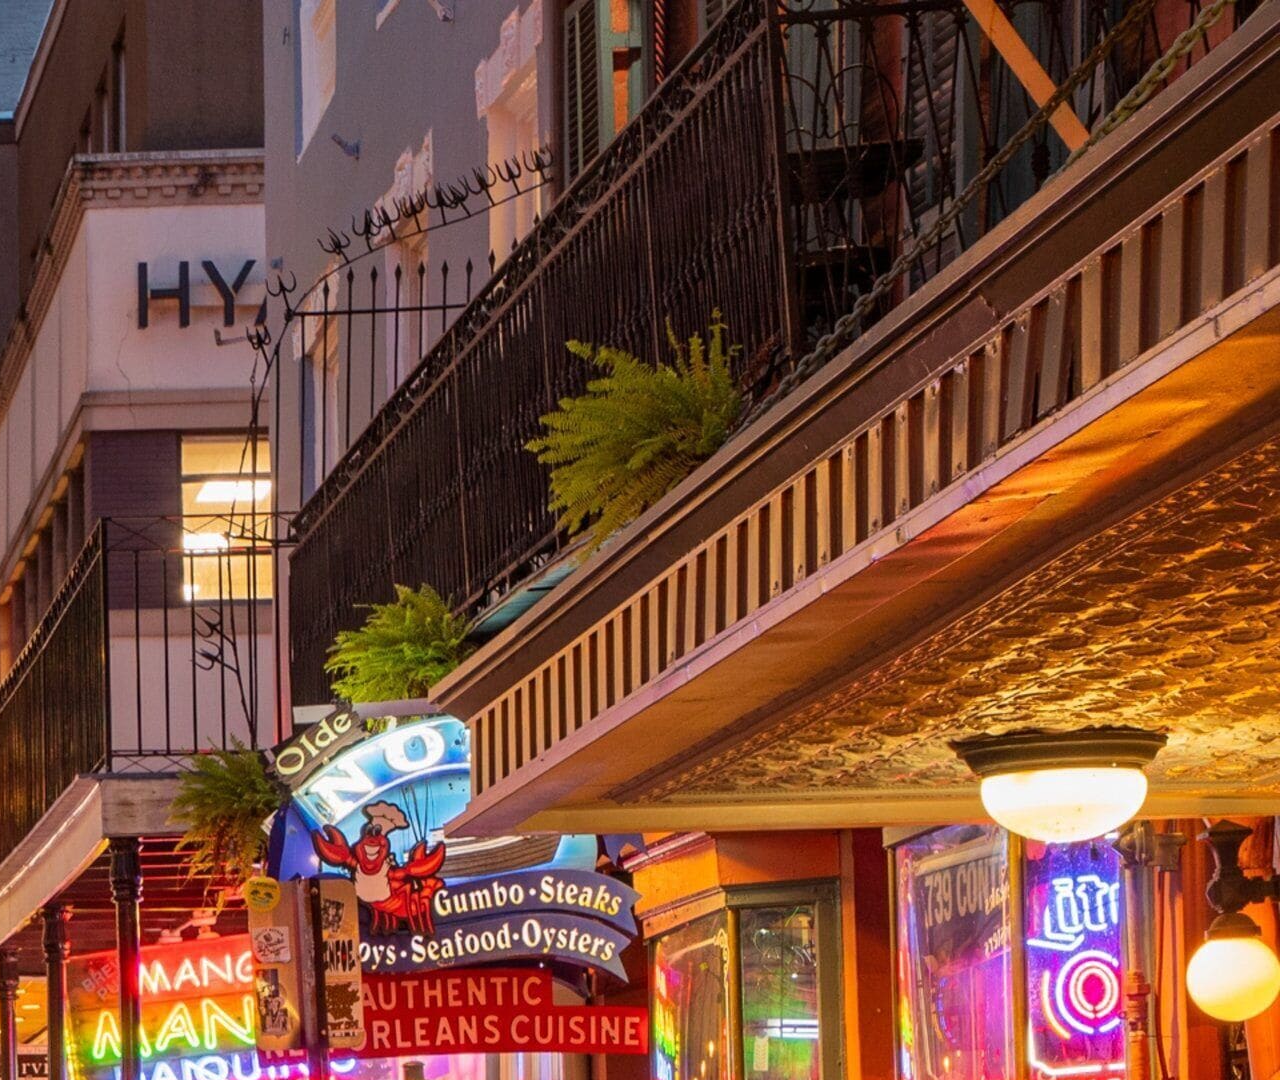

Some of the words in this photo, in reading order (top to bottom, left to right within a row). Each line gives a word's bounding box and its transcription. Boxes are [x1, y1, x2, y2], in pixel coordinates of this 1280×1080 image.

[138, 259, 267, 329] HY
[276, 713, 352, 775] Olde
[310, 726, 445, 826] NO
[434, 880, 523, 917] Gumbo
[540, 875, 623, 916] Steaks
[411, 922, 512, 963] Seafood
[522, 919, 616, 962] Oysters
[139, 951, 253, 995] MANG
[360, 976, 542, 1011] AUTHENTIC
[93, 996, 255, 1060] MAN
[510, 1013, 640, 1046] CUISINE
